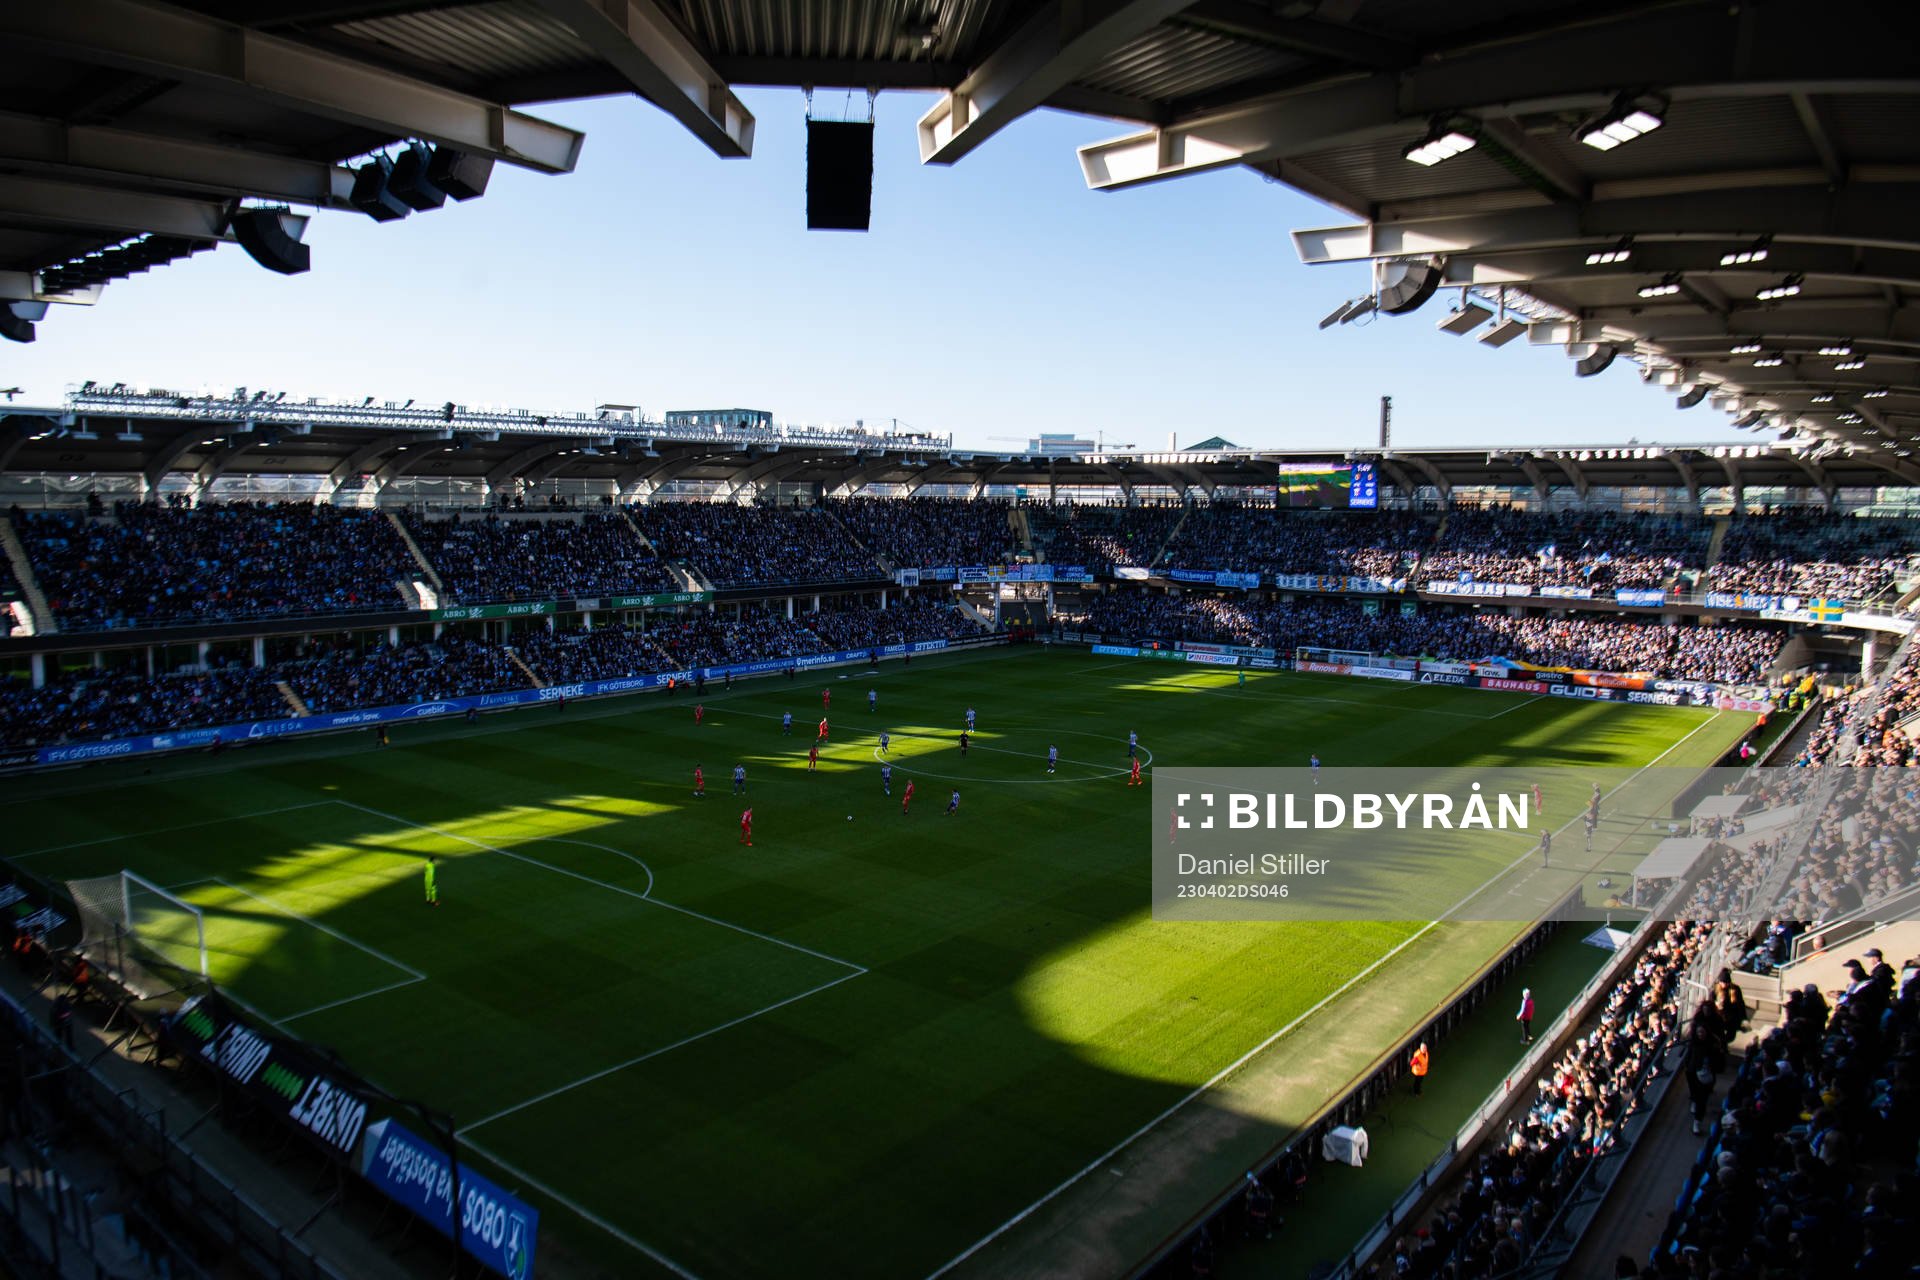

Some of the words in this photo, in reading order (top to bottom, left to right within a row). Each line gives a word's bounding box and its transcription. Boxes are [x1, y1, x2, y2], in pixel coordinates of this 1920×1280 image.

[915, 640, 947, 651] EFFEKTIV
[1193, 654, 1236, 664] INTERSPORT
[1309, 663, 1338, 672] Renova
[656, 671, 693, 686] SERNEKE
[1433, 674, 1465, 684] ELEDA
[1535, 672, 1563, 681] gastro
[1487, 680, 1540, 691] BAUHAUS
[539, 684, 584, 700] SERNEKE
[1627, 691, 1680, 705] SERNEKE
[289, 1075, 369, 1153] UNIBET
[462, 1187, 506, 1249] OBOS
